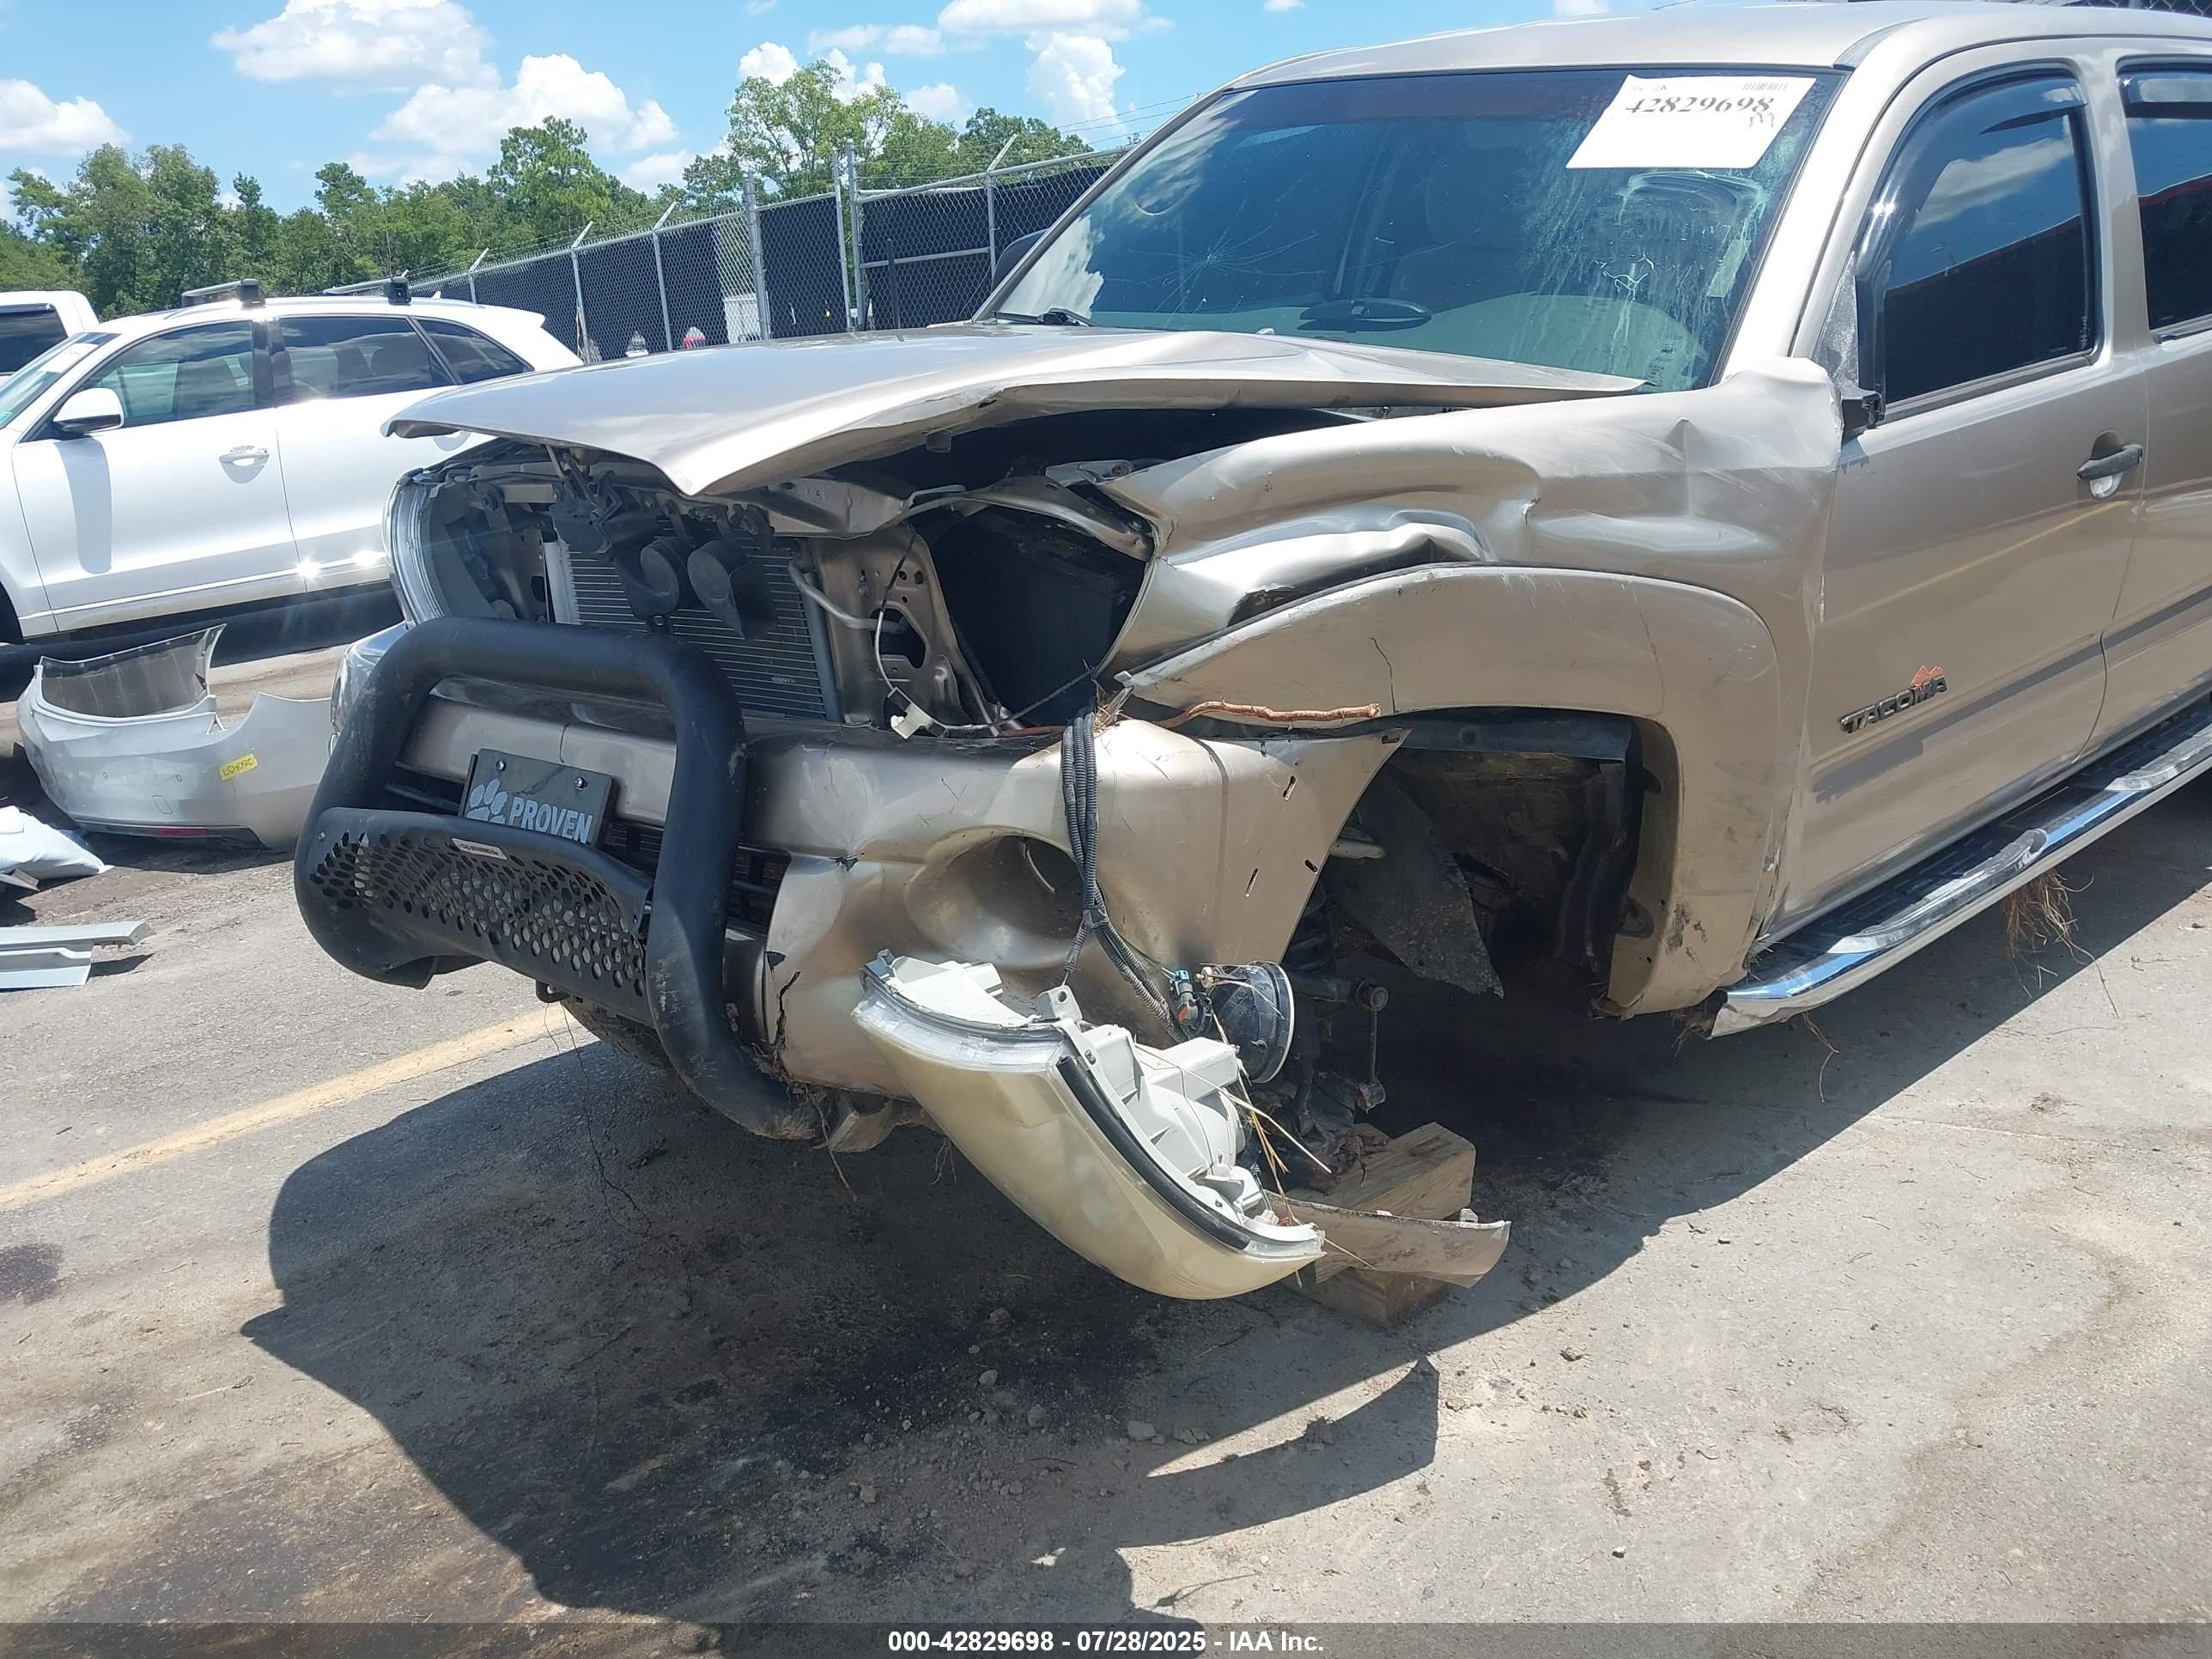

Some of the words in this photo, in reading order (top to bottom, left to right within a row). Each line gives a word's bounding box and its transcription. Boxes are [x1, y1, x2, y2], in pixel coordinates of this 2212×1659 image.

[1626, 95, 1775, 113] 42829698
[1839, 674, 1948, 733] TACOMA
[508, 796, 593, 844] PROVEN
